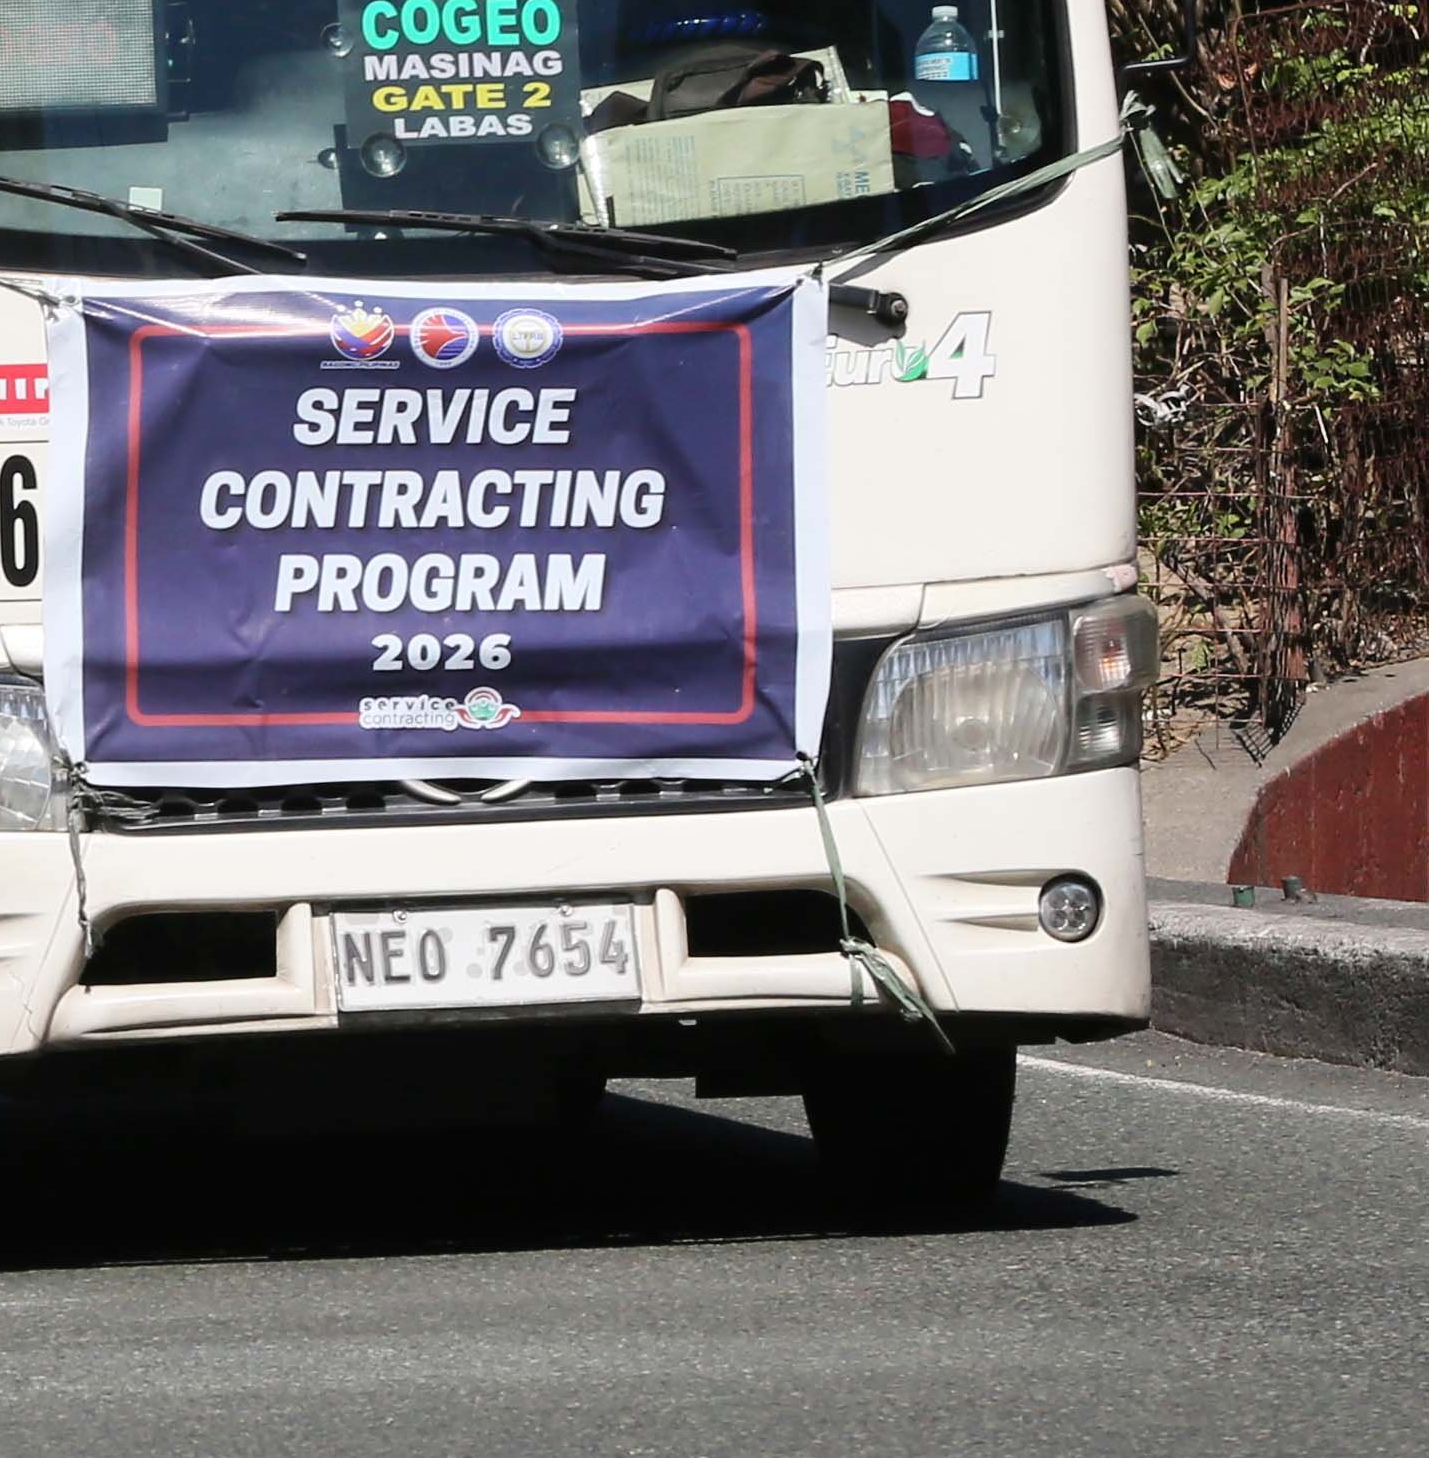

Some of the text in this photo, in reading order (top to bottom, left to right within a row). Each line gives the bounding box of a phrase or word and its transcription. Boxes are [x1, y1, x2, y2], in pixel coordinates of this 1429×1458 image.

[364, 50, 563, 81] MASINAG
[372, 82, 552, 112] GATE 2
[394, 114, 533, 139] LABAS
[292, 387, 577, 446] SERVICE
[199, 469, 667, 530] CONTRACTING
[273, 552, 607, 612] PROGRAM
[371, 632, 512, 671] 2026
[362, 711, 456, 727] contracting
[363, 694, 455, 711] service
[343, 920, 629, 986] NEO 7654
